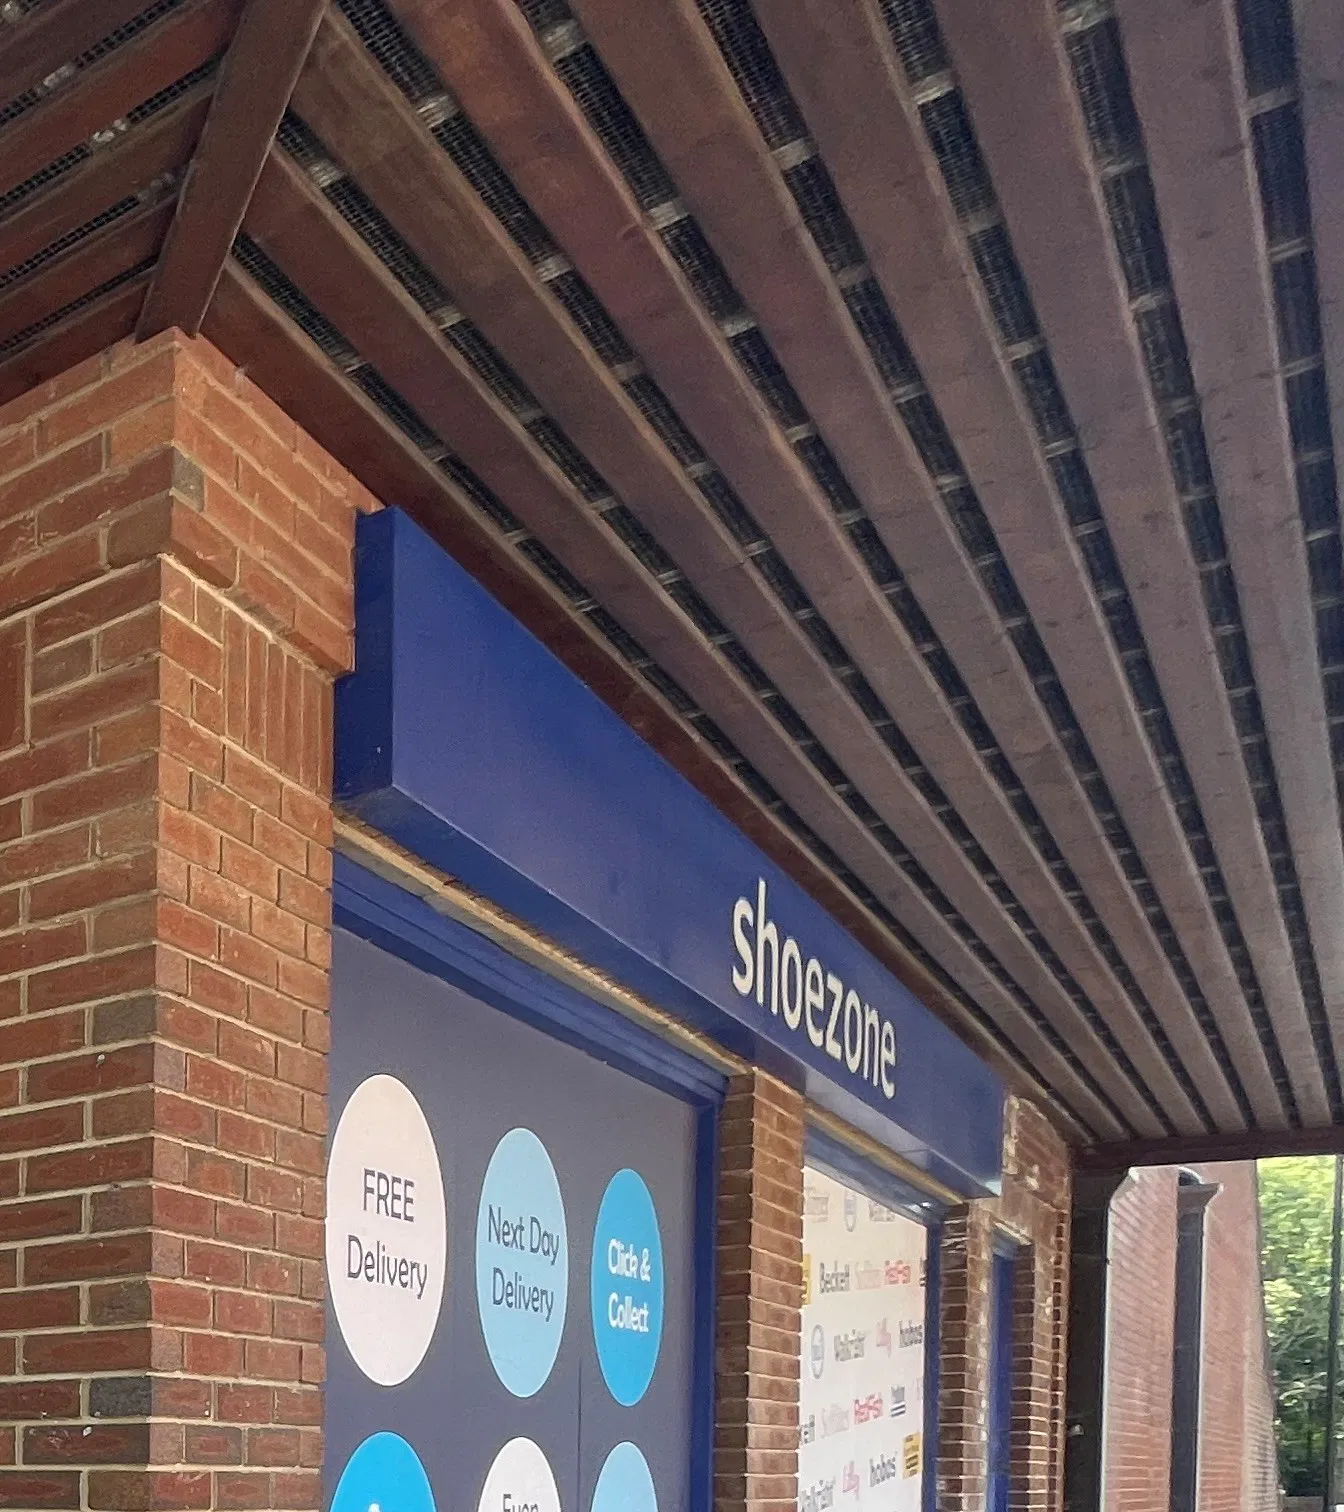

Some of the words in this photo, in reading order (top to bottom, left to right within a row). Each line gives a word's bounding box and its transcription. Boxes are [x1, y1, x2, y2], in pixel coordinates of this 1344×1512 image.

[732, 876, 897, 1100] shoezone
[362, 1167, 415, 1223] FREE
[487, 1203, 526, 1252] Next
[529, 1215, 560, 1266] Day
[607, 1238, 638, 1279] Click
[640, 1247, 651, 1281] &
[346, 1234, 428, 1300] Delivery
[491, 1266, 555, 1322] Delivery
[608, 1292, 649, 1332] Collect
